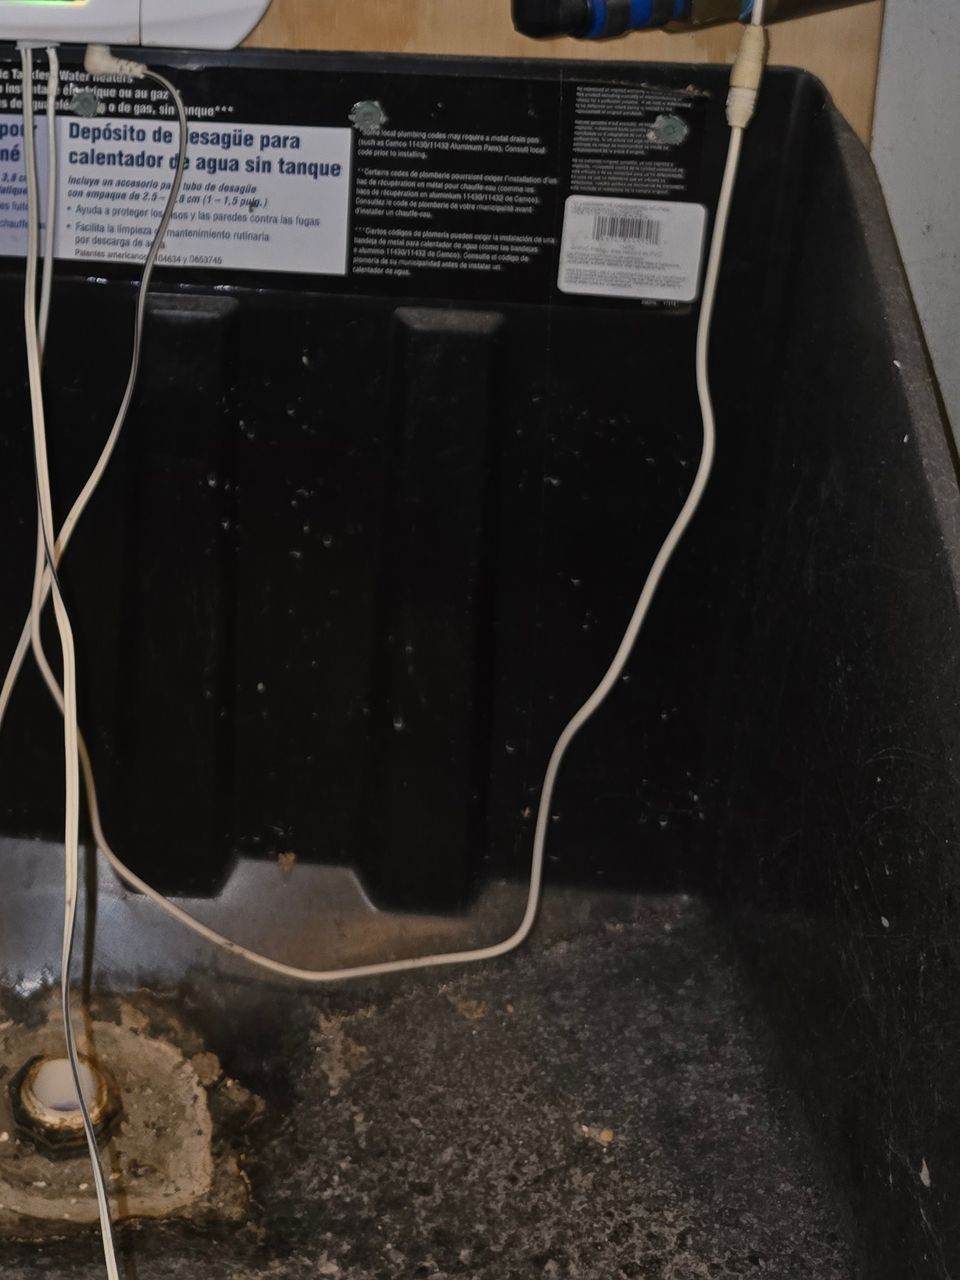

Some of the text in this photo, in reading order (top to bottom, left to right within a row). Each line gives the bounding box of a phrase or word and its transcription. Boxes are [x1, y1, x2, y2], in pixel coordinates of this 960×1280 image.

[59, 70, 89, 82] Water
[119, 87, 132, 98] ou
[135, 88, 148, 98] au
[10, 97, 22, 108] de
[109, 104, 114, 112] o
[118, 102, 130, 112] de
[134, 103, 156, 115] gas,
[159, 102, 174, 115] sin
[68, 122, 148, 145] Depósito
[152, 125, 173, 143] de
[260, 132, 300, 151] para
[68, 149, 163, 169] calentador
[196, 156, 239, 176] agua
[245, 156, 272, 174] sin
[278, 159, 341, 181] tanque
